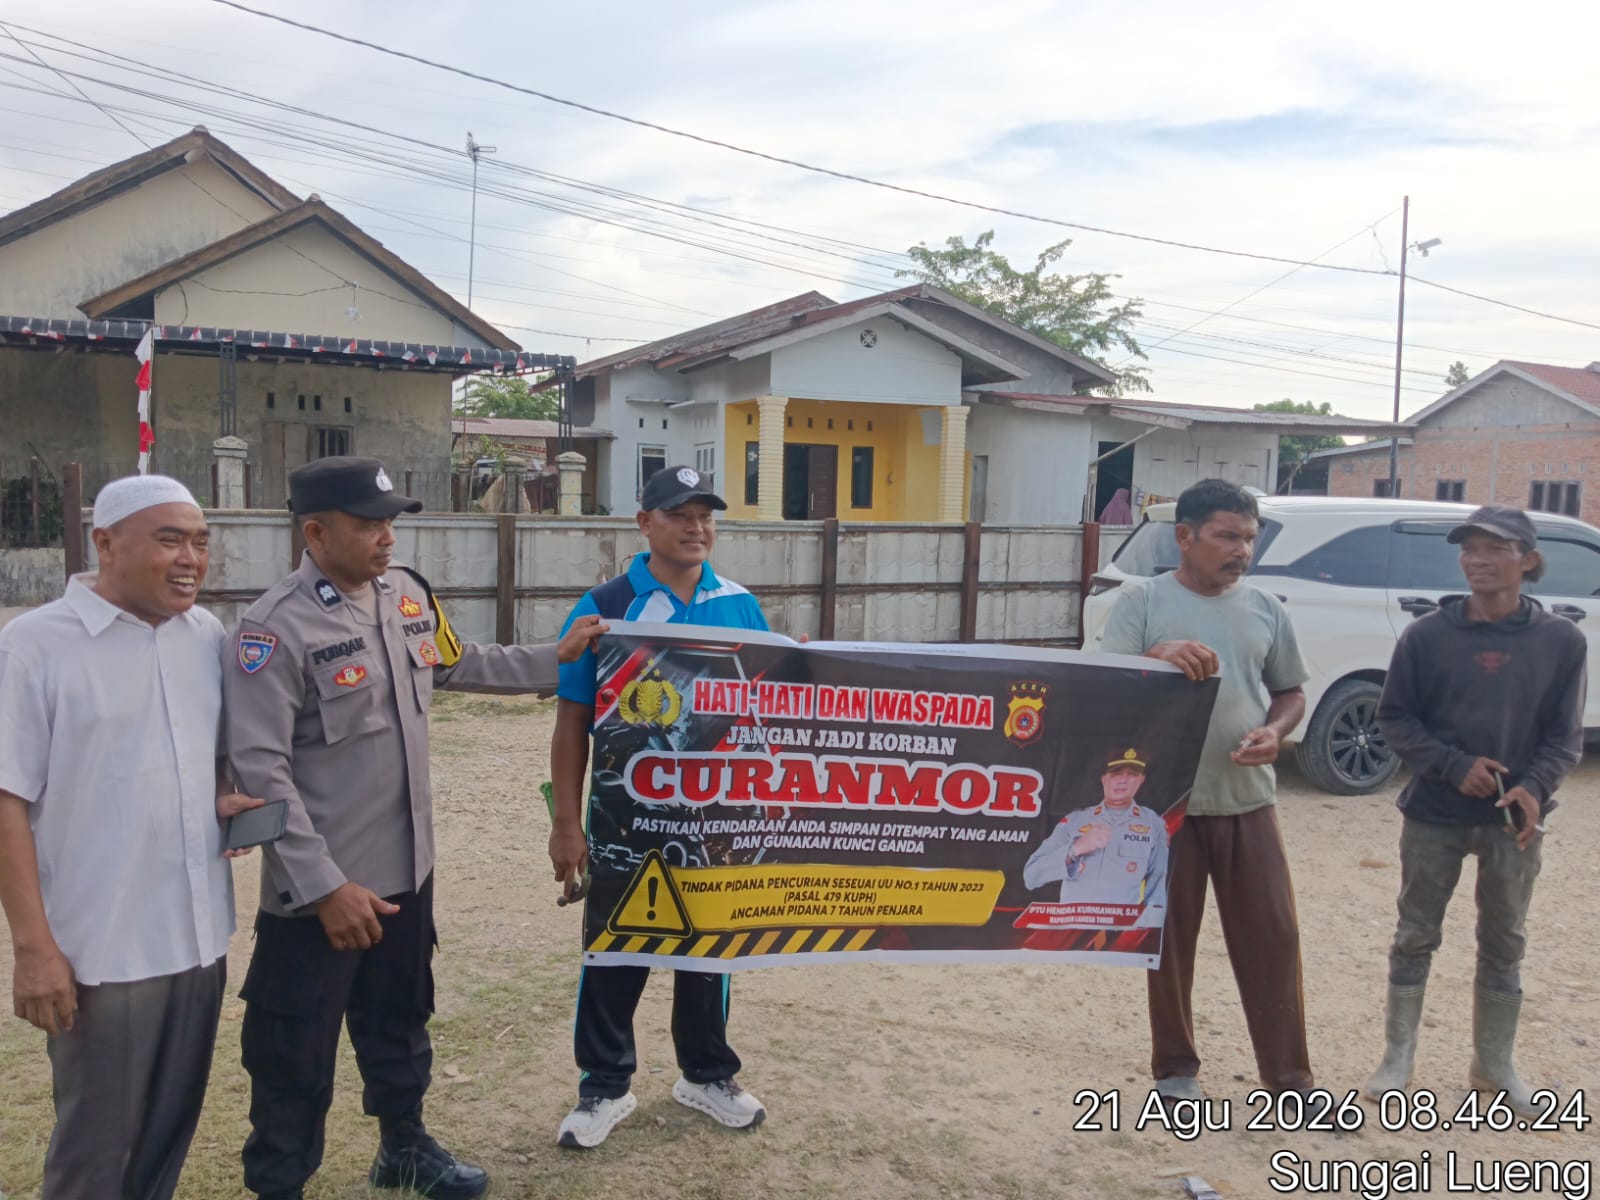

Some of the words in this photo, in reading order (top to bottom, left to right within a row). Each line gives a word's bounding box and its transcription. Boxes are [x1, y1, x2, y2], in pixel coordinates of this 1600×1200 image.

[1011, 683, 1048, 694] ACEH
[694, 680, 813, 719] HATI-HATI
[818, 686, 867, 720] DAN
[872, 689, 993, 727] WASPADA
[727, 725, 812, 747] JANGAN
[814, 729, 864, 750] JADI
[867, 732, 956, 755] KORBAN
[628, 754, 1043, 814] CURANMOR
[632, 817, 700, 835] PASTIKAN
[702, 819, 786, 834] KENDARAAN
[787, 820, 826, 833] ANDA
[828, 821, 881, 836] SIMPAN
[882, 824, 947, 839] DITEMPAT
[950, 827, 986, 841] YANG
[988, 830, 1029, 843] AMAN
[732, 834, 760, 850] DAN
[763, 835, 831, 850] GUNAKAN
[832, 837, 876, 852] KUNCI
[878, 839, 925, 853] GANDA
[681, 881, 722, 893] TINDAK
[727, 880, 764, 891] PIDANA
[767, 877, 830, 889] PENCURIAN
[832, 878, 875, 889] SESEUAI
[878, 879, 893, 889] UU
[895, 880, 919, 891] NO.1
[922, 882, 958, 892] TAHUN
[959, 882, 984, 892] 2023
[784, 892, 821, 904] (PASAL
[823, 892, 841, 902] 479
[843, 892, 877, 904] KUPH)
[730, 905, 784, 920] ANCAMAN
[787, 905, 828, 915] PIDANA
[831, 905, 836, 915] 7
[838, 905, 874, 916] TAHUN
[876, 905, 923, 916] PENJARA
